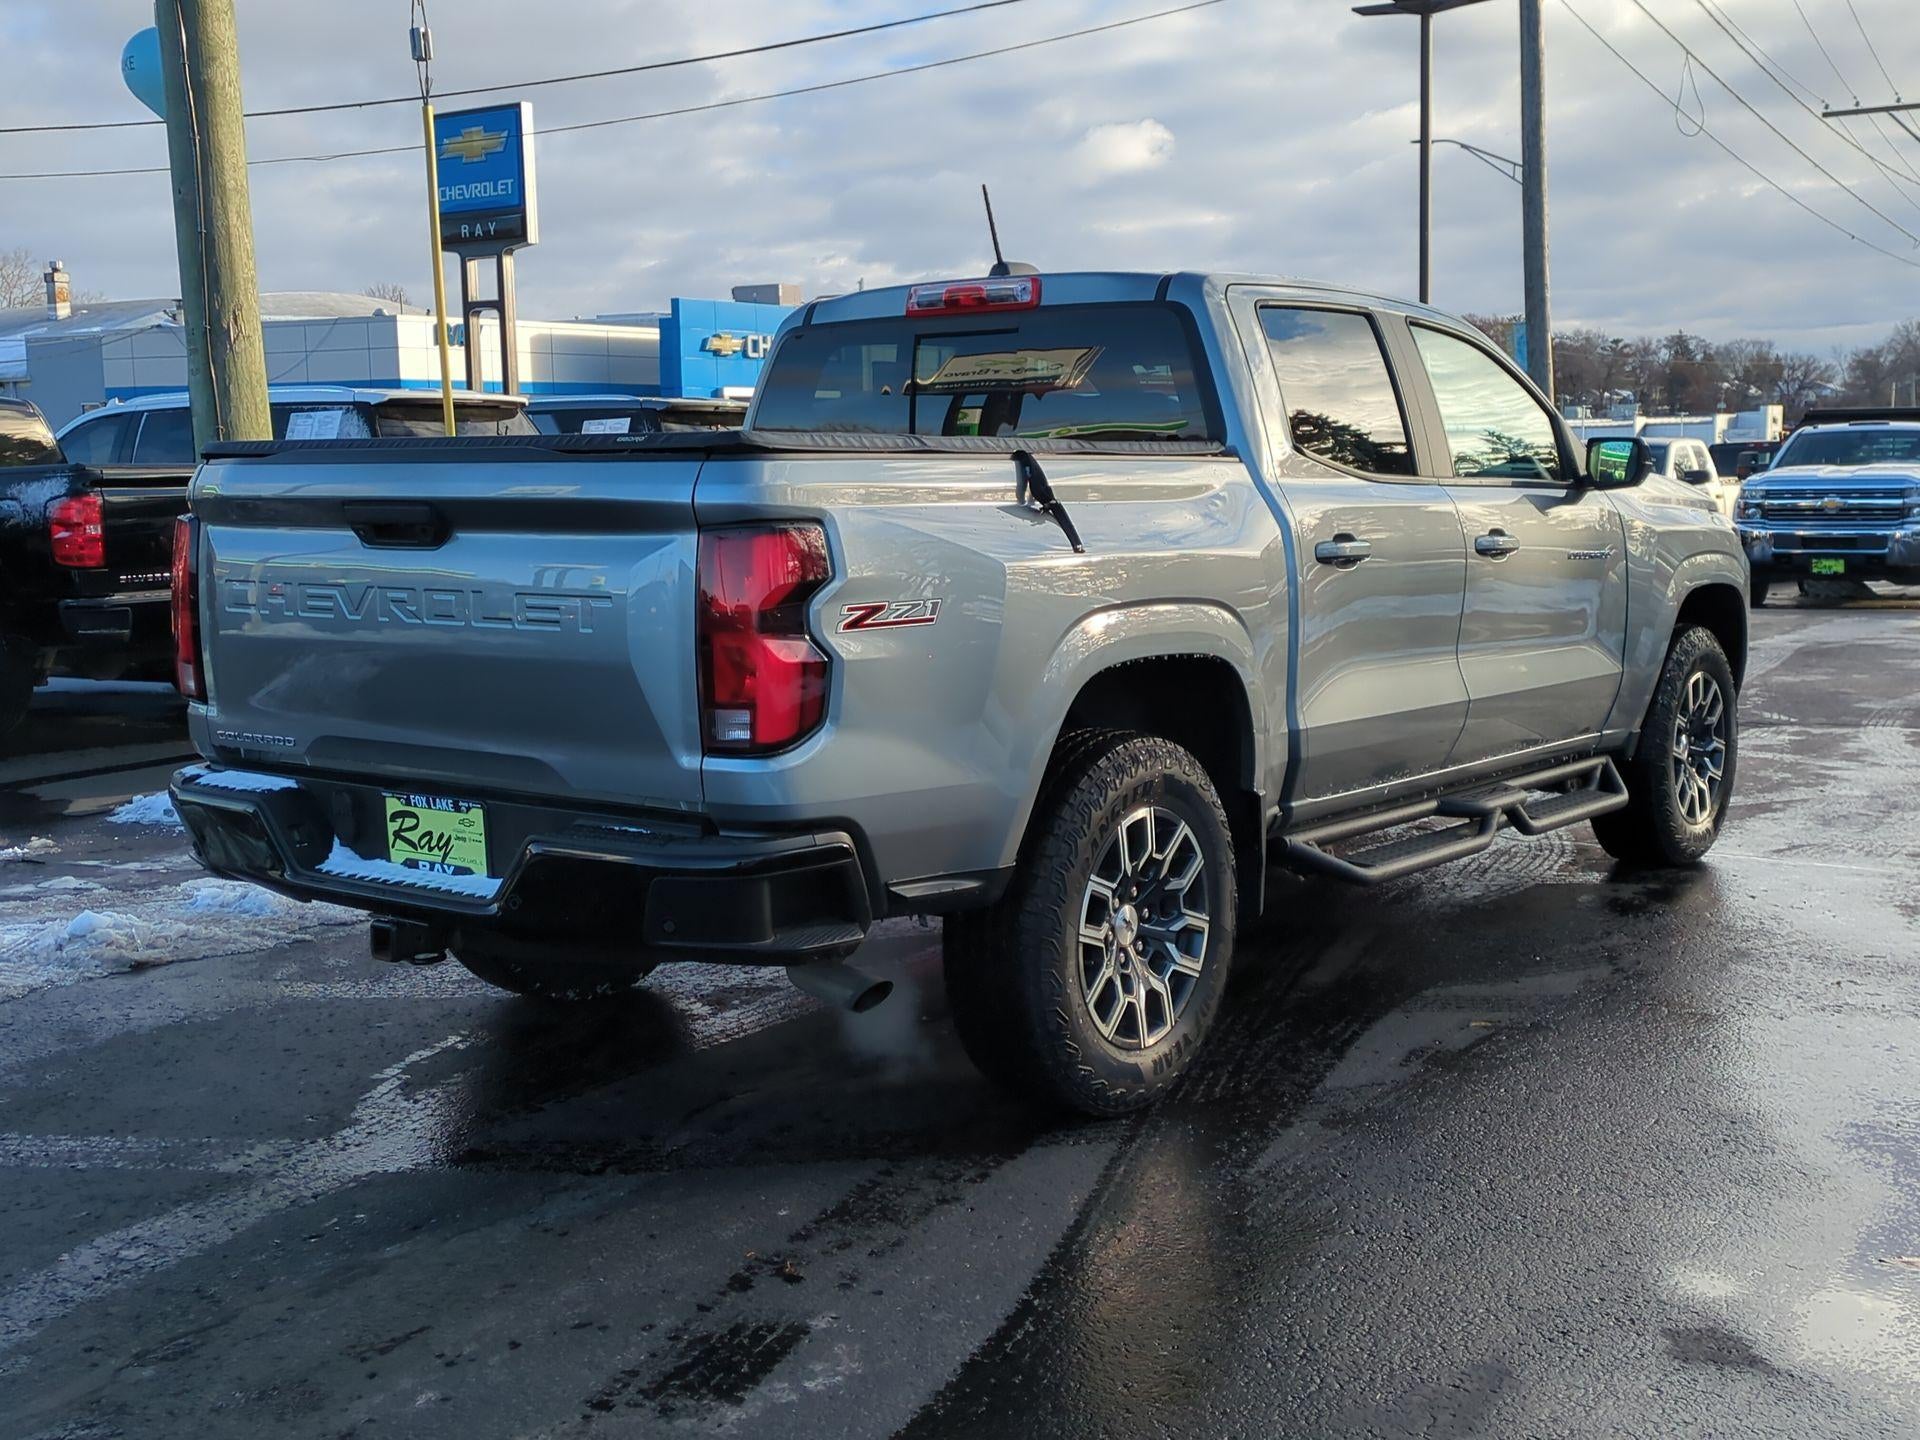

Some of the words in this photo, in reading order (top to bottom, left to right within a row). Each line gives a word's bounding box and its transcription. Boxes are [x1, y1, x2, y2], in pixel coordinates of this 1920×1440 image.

[439, 178, 514, 202] CHEVROLET
[461, 221, 496, 238] RAY
[224, 578, 613, 634] CHEVROLET
[835, 598, 942, 634] Z71
[216, 730, 296, 747] COLORADO
[409, 794, 429, 809] FOX
[430, 798, 456, 812] LAKE
[388, 809, 455, 865] Ray
